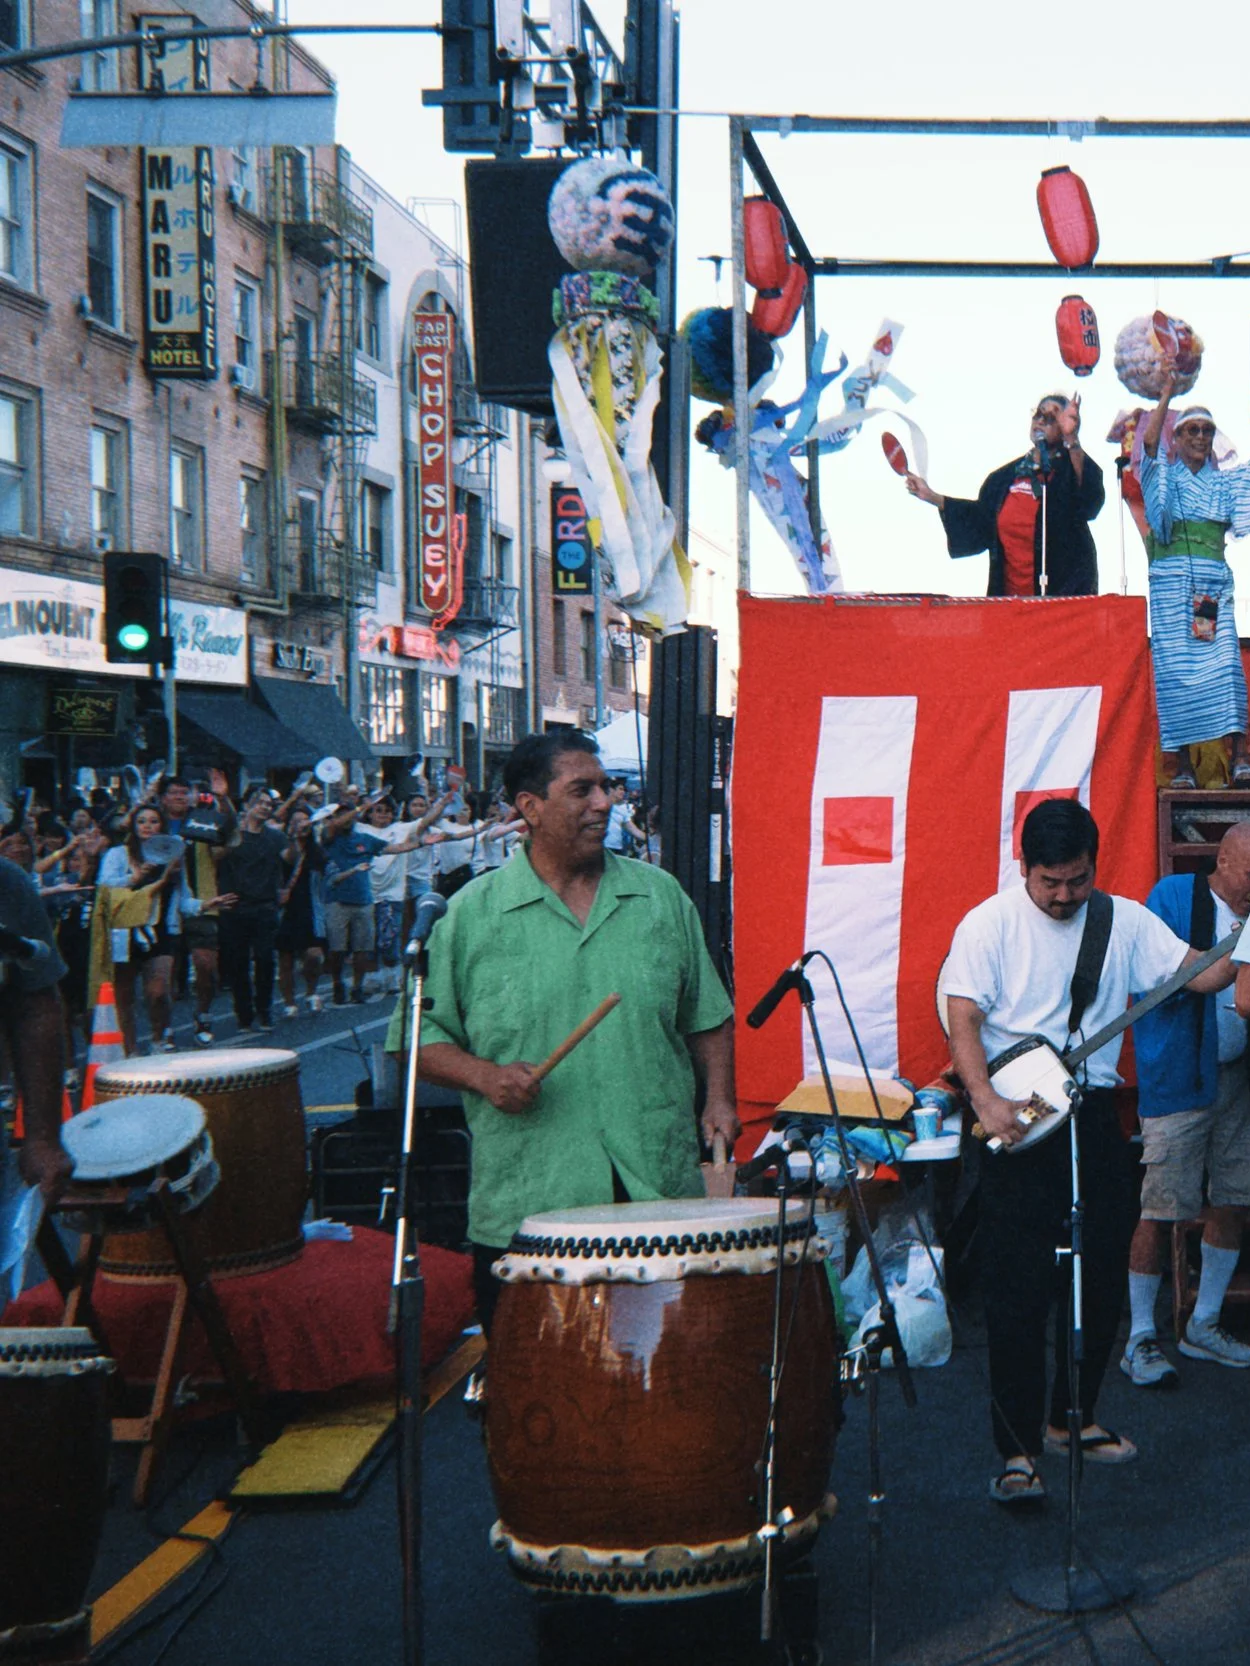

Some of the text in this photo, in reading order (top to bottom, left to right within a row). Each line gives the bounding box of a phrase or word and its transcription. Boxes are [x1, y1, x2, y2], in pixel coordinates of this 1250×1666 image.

[203, 259, 216, 370] HOTEL
[415, 321, 446, 334] FAR
[150, 350, 201, 365] HOTEL
[421, 353, 446, 596] CHOP SUEY
